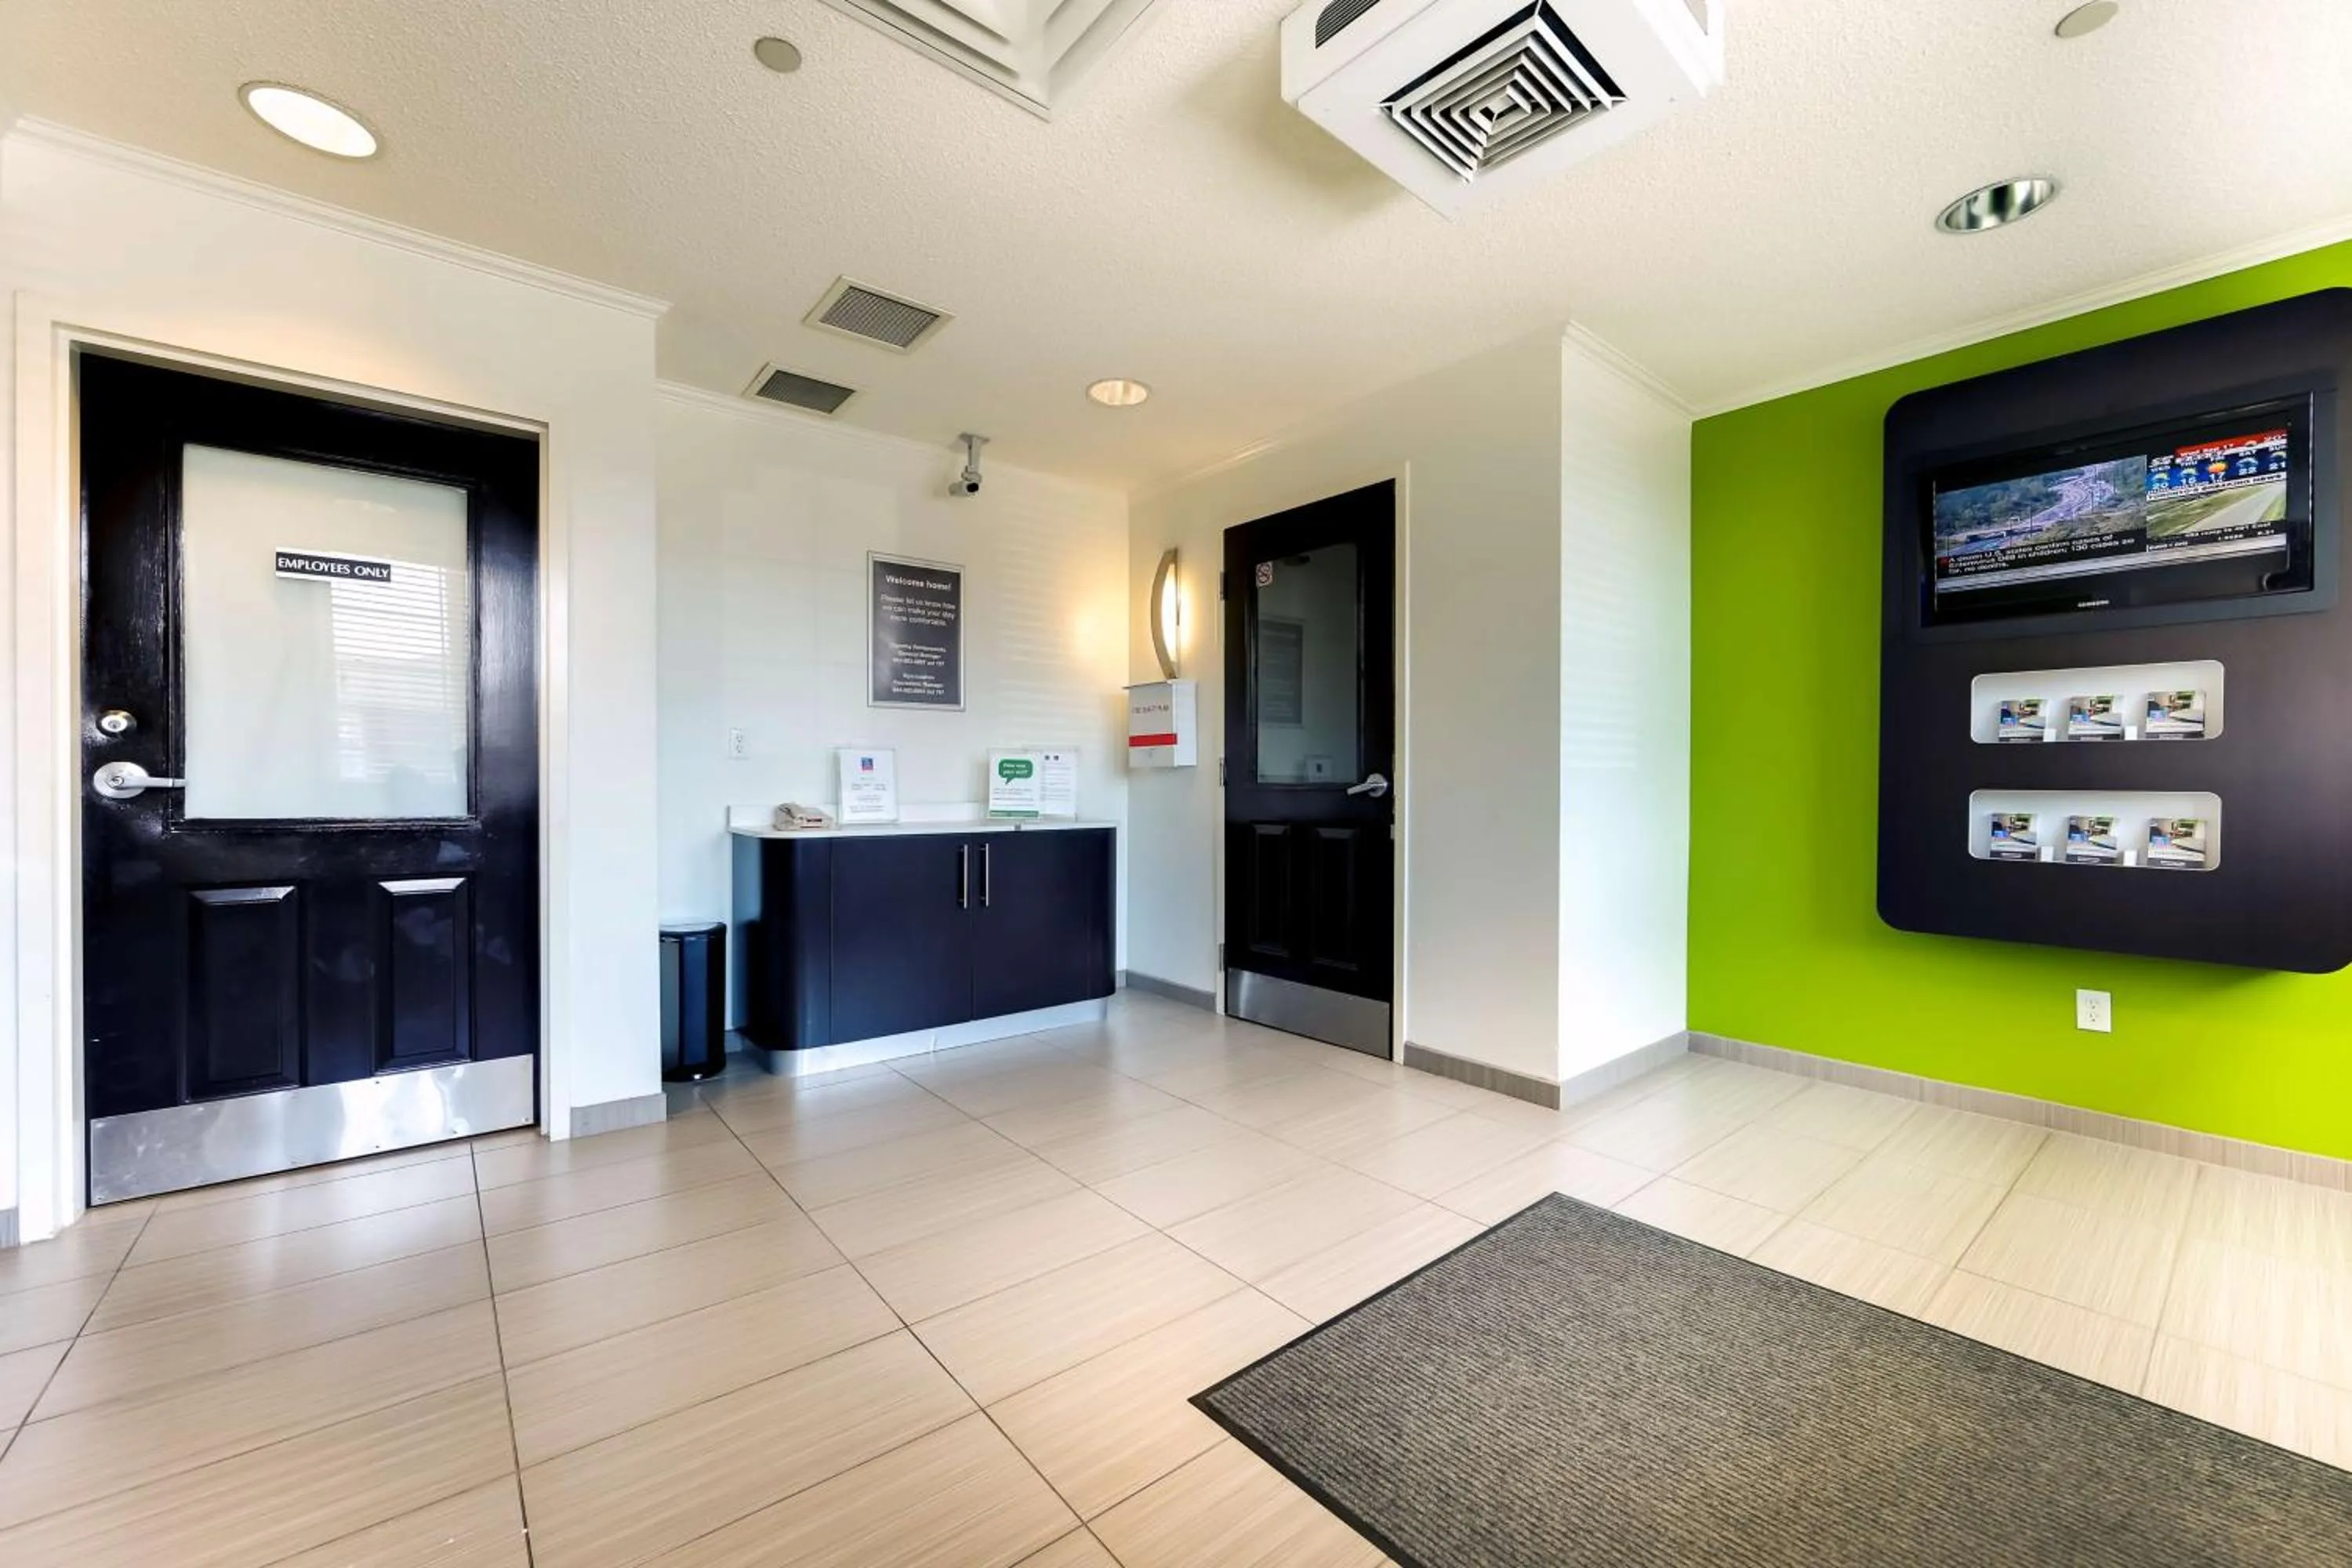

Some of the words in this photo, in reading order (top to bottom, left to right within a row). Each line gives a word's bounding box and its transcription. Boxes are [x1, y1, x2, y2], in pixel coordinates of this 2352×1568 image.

[278, 557, 350, 574] EMPLOYEES
[354, 565, 390, 578] ONLY
[885, 574, 924, 587] Welcome
